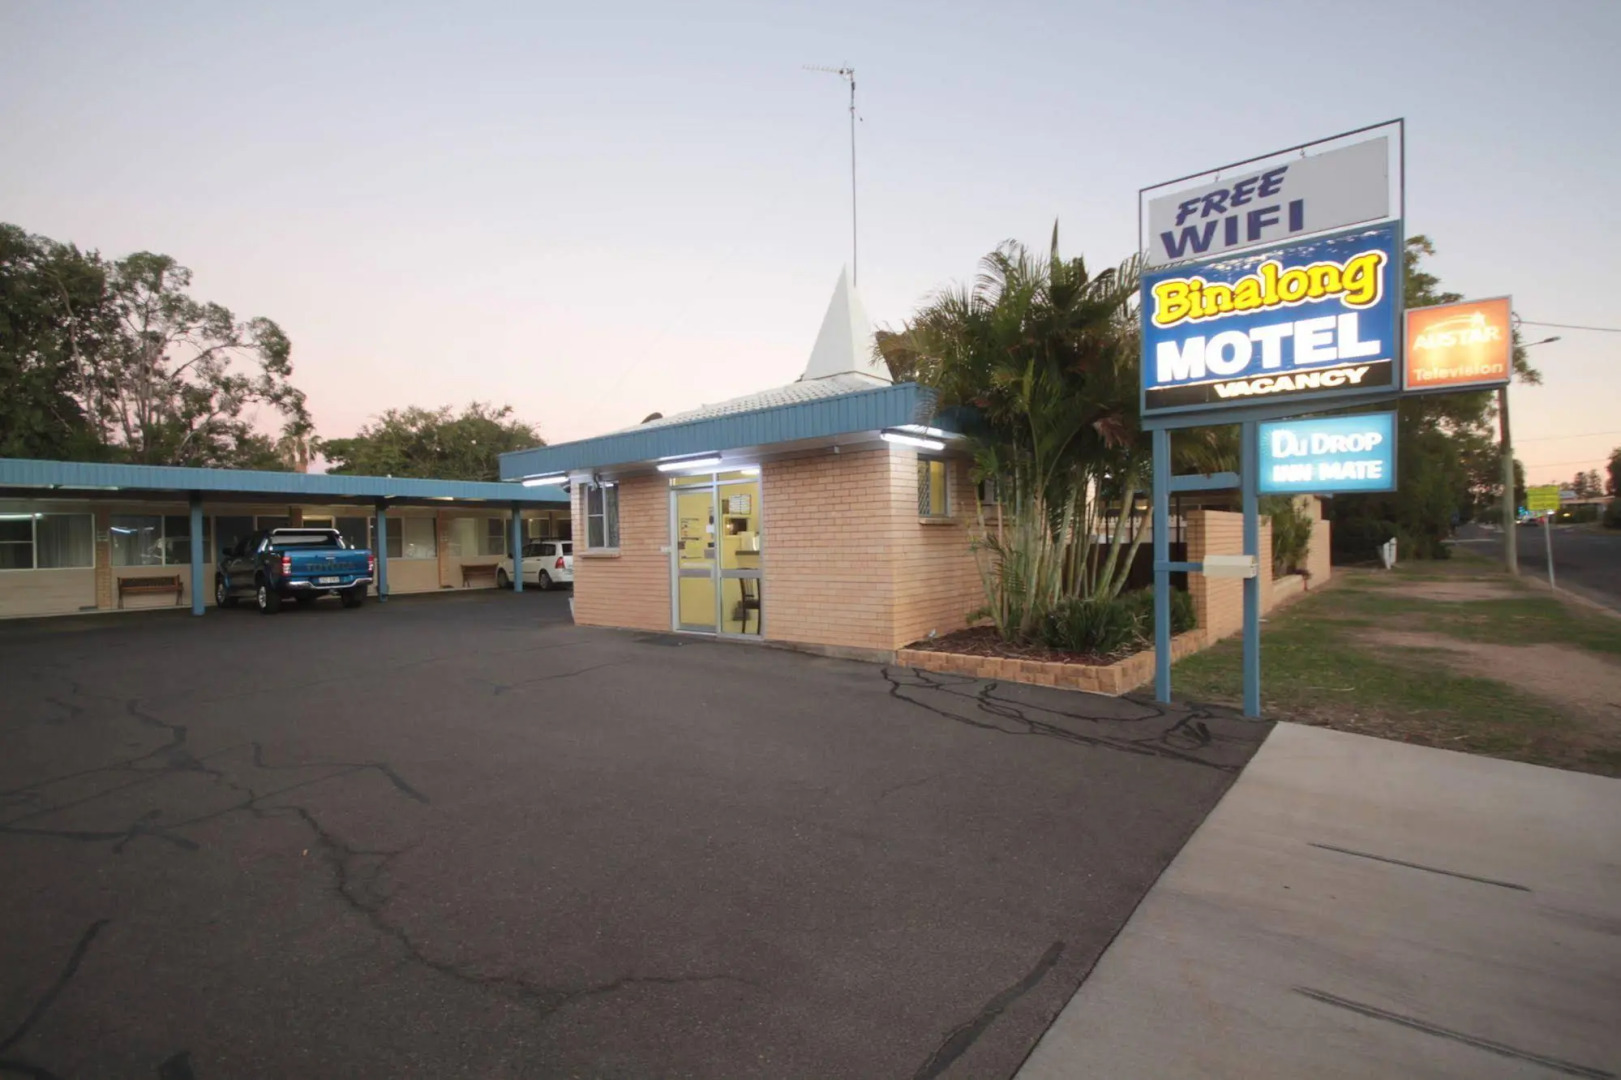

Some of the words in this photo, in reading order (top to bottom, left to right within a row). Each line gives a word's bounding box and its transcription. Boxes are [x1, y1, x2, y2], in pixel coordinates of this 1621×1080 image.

[1175, 166, 1288, 226] FREE
[1160, 199, 1304, 259] WIFI
[1154, 252, 1383, 326] Binalong
[1156, 313, 1381, 382] MOTEL
[1214, 366, 1370, 398] VACANCY
[1412, 362, 1504, 381] Television
[1311, 431, 1383, 455] DROP
[1319, 460, 1383, 481] MATE
